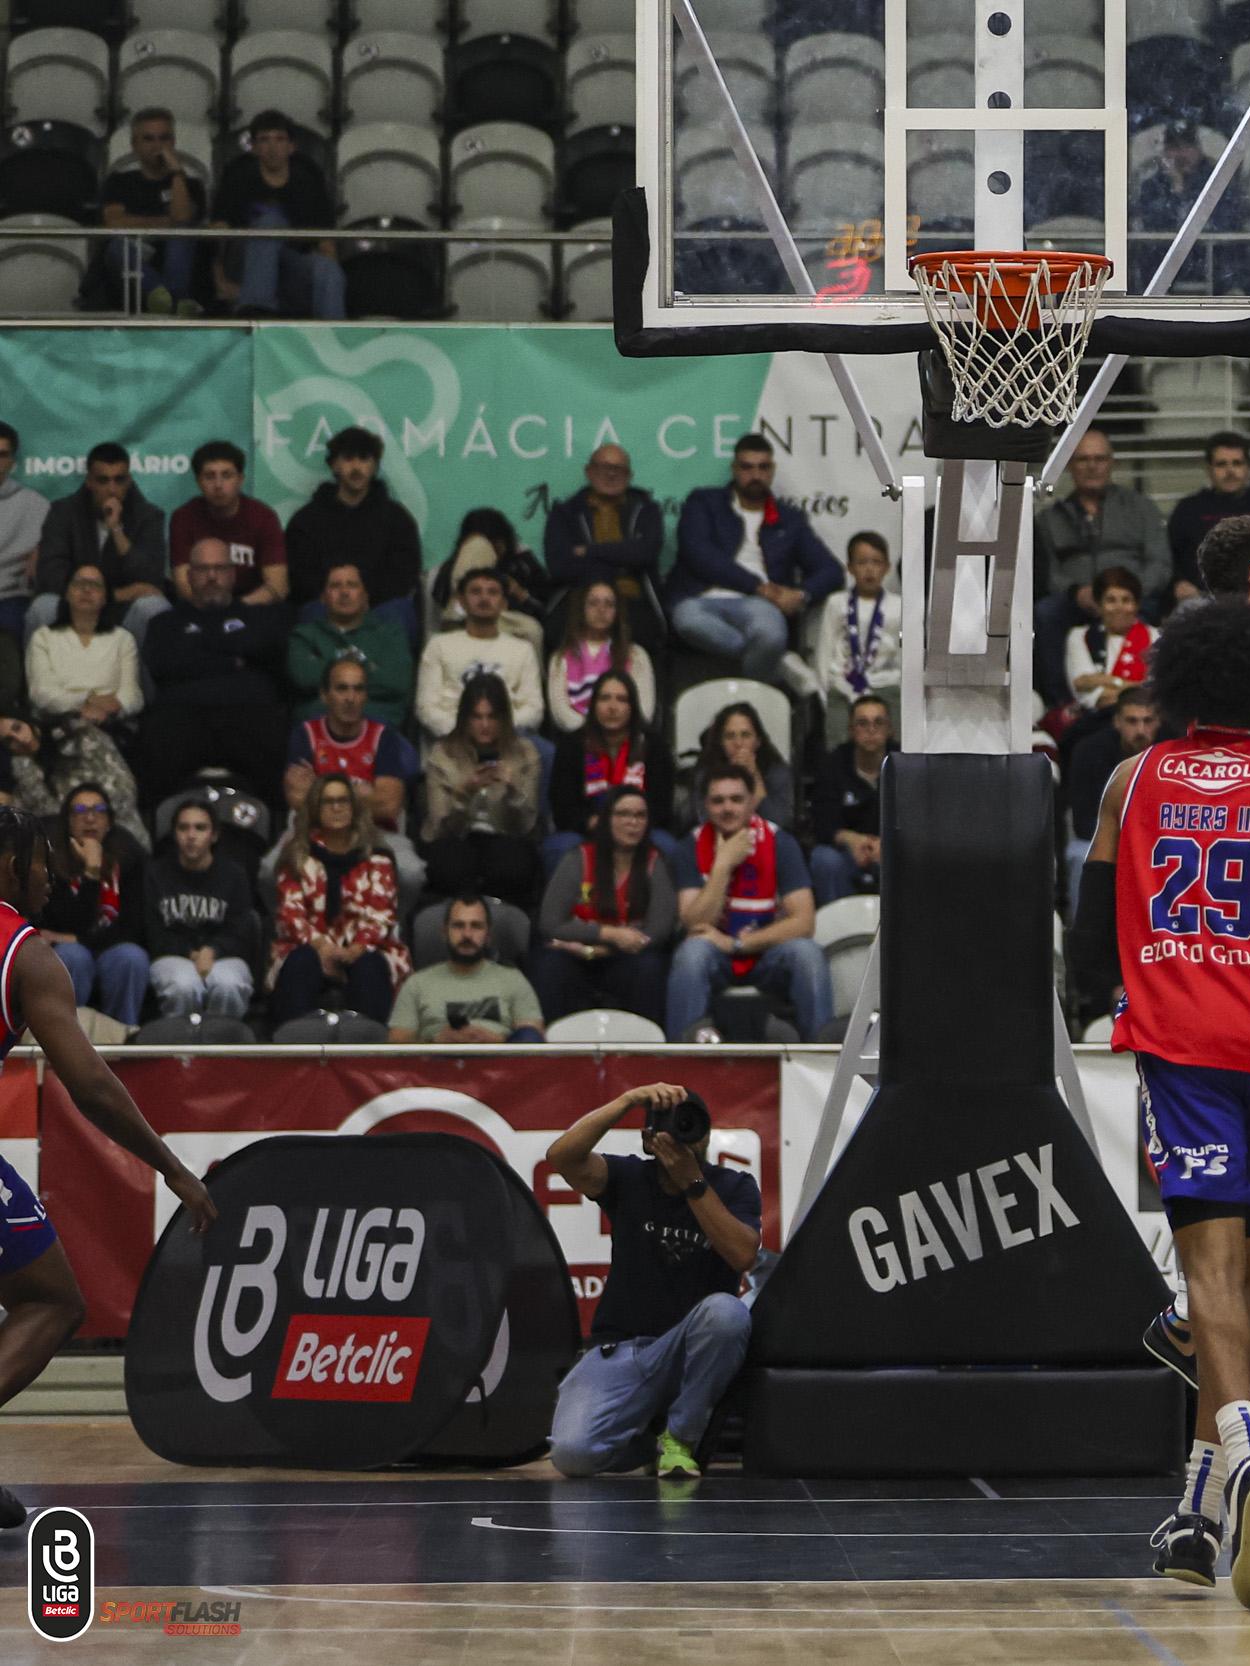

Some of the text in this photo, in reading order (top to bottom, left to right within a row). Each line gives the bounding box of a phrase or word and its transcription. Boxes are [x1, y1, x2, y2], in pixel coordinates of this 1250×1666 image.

[657, 414, 924, 459] CENTRA
[1160, 803, 1228, 831] AYERS
[1172, 1144, 1229, 1157] GRUPO
[848, 1143, 1080, 1293] GAVEX
[286, 1332, 412, 1385] Betclic
